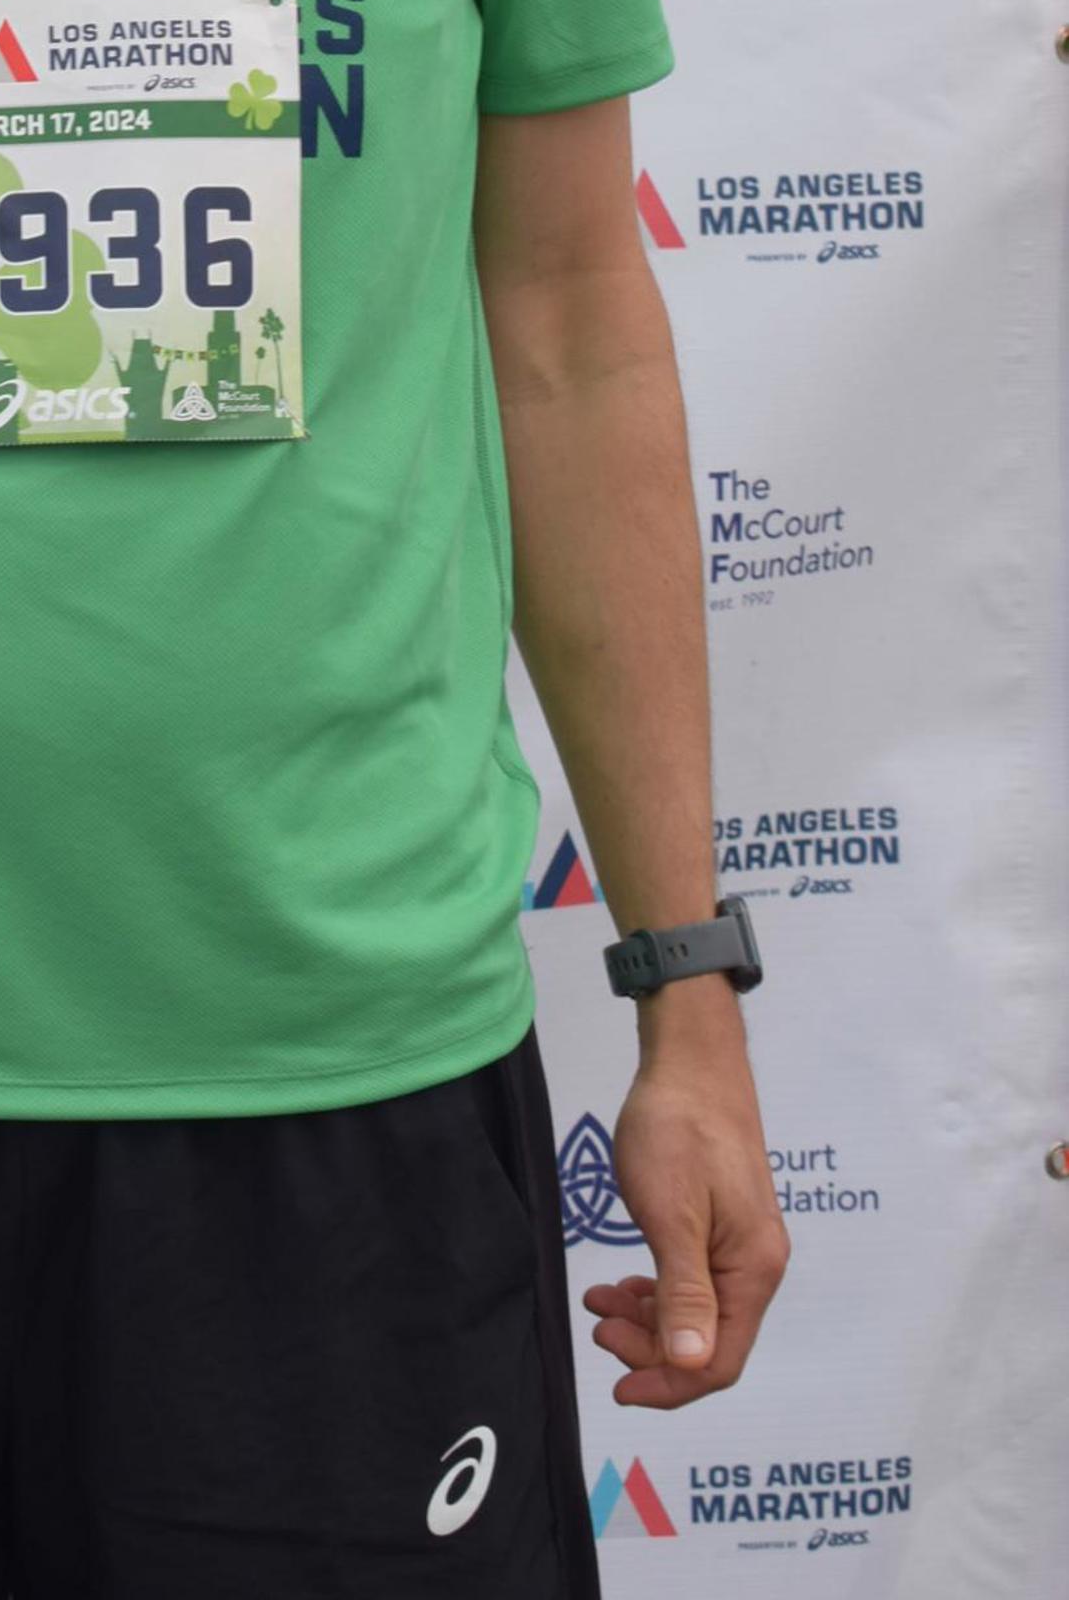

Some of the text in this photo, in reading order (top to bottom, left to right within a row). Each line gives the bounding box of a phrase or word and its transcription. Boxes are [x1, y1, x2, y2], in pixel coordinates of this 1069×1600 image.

[49, 20, 231, 43] LOS ANGELES
[50, 43, 232, 70] MARATHON
[50, 112, 82, 136] 17,
[89, 109, 152, 132] 2024
[699, 172, 922, 200] LOS ANGELES
[700, 201, 923, 235] MARATHON
[28, 387, 129, 421] asics
[709, 470, 770, 501] The
[712, 508, 844, 542] McCourt
[711, 542, 873, 584] Foundation
[742, 590, 774, 606] 1992
[754, 808, 897, 837] ANGELES
[719, 837, 899, 874] ARATHON
[768, 1144, 836, 1172] ourt
[777, 1180, 879, 1212] dation
[691, 1456, 911, 1489] LOS ANGELES
[691, 1484, 910, 1523] MARATHON
